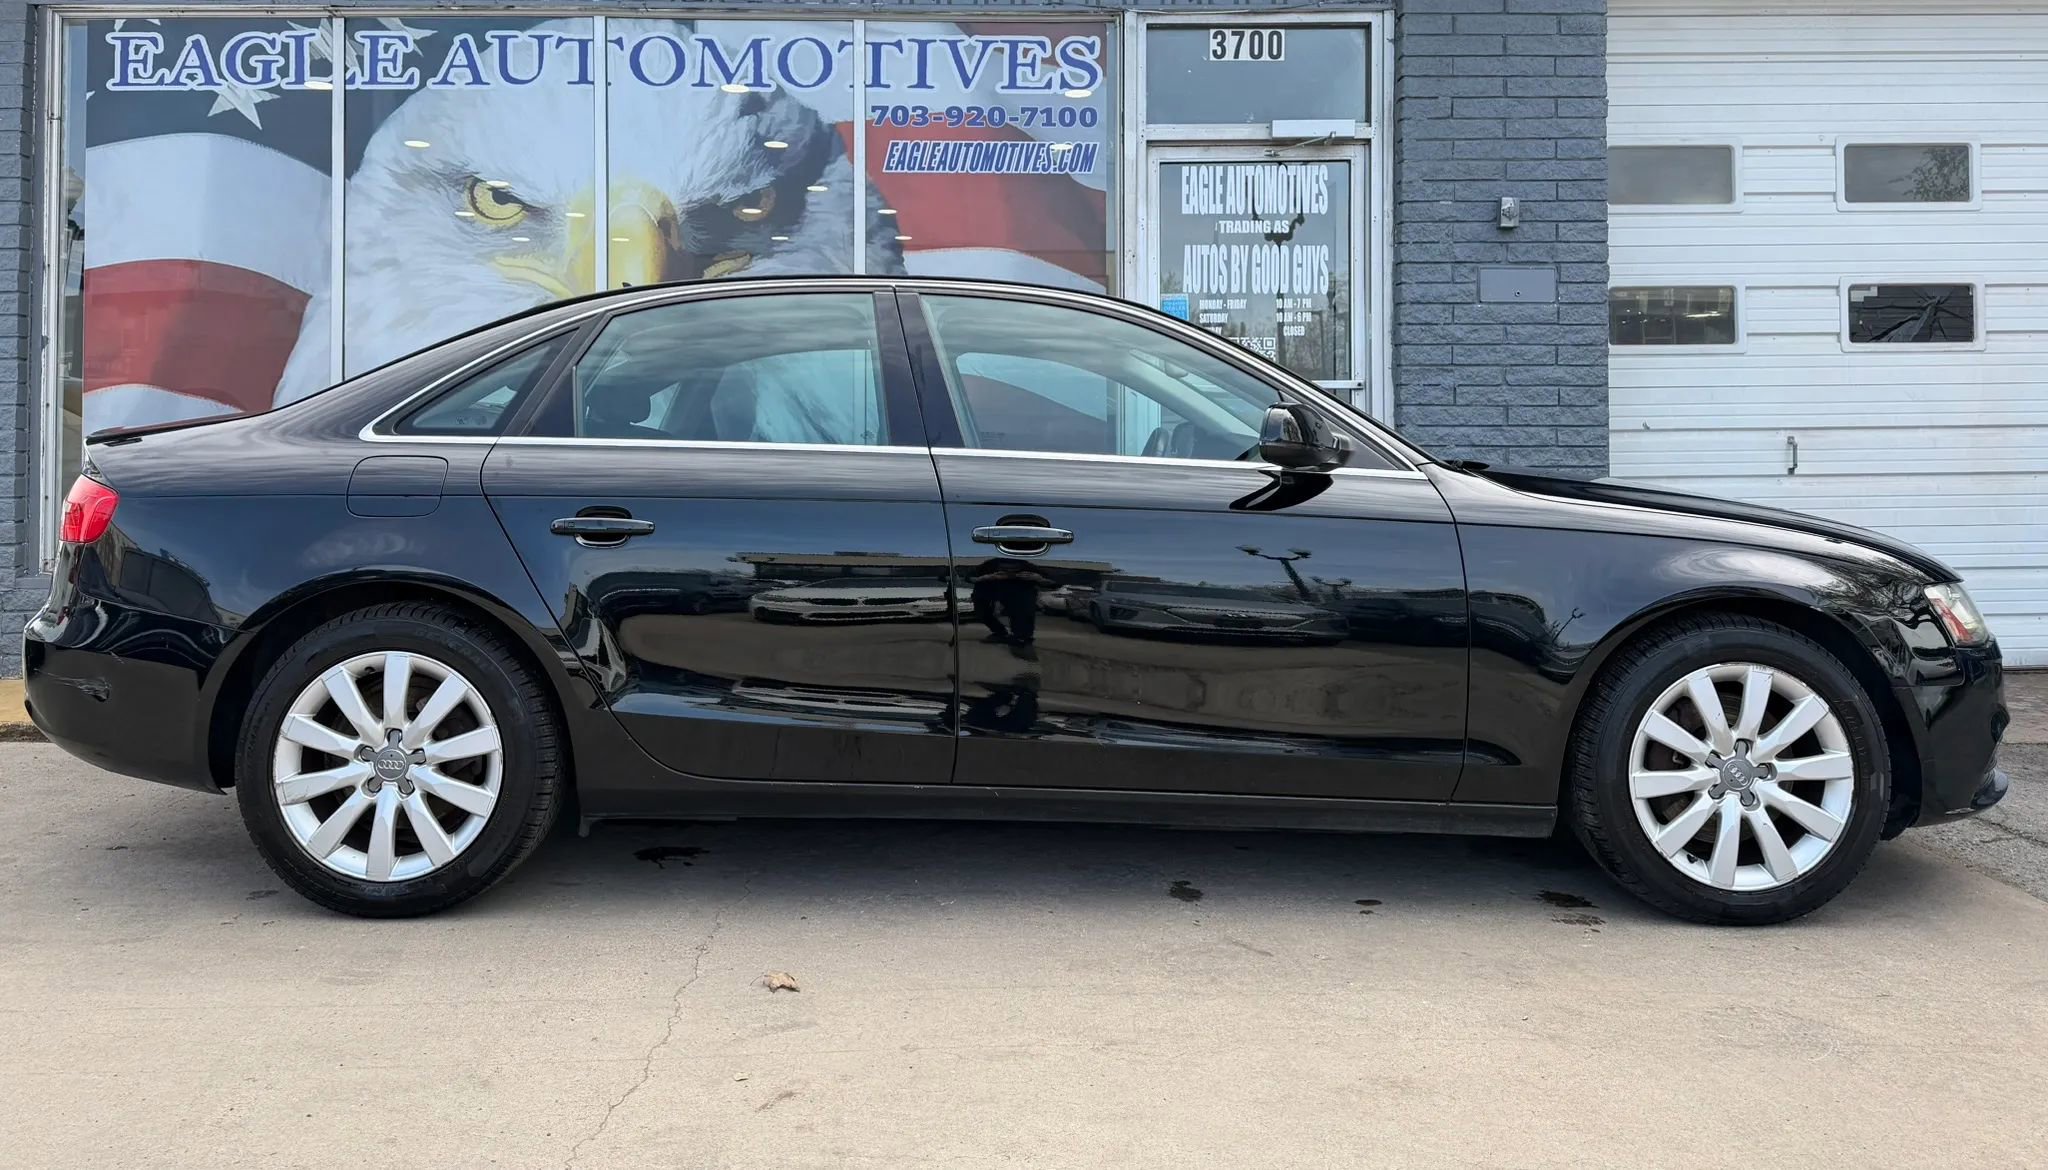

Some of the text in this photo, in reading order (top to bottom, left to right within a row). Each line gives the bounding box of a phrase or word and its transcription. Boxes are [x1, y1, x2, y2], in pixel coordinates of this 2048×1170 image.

[1212, 30, 1283, 60] 3700
[107, 31, 1103, 94] EAGLE AUTOMOTIVES
[871, 105, 1099, 128] 703-920-7100
[883, 140, 1101, 174] EAGLEAUTOMOTIVES.COM
[1181, 164, 1329, 216] EAGLE AUTOMOTIVES
[1219, 220, 1290, 234] TRADING AS
[1183, 244, 1329, 295] AUTOS BY GOOD GUYS
[1199, 298, 1223, 310] MONDAY
[1227, 298, 1248, 310] FRIDAY
[1276, 298, 1283, 309] 10
[1283, 298, 1293, 309] AM
[1302, 298, 1312, 309] PM
[1199, 312, 1229, 324] SATURDAY
[1276, 312, 1283, 322] 10
[1283, 312, 1293, 322] AM
[1302, 312, 1312, 322] PM
[1283, 325, 1306, 337] CLOSED
